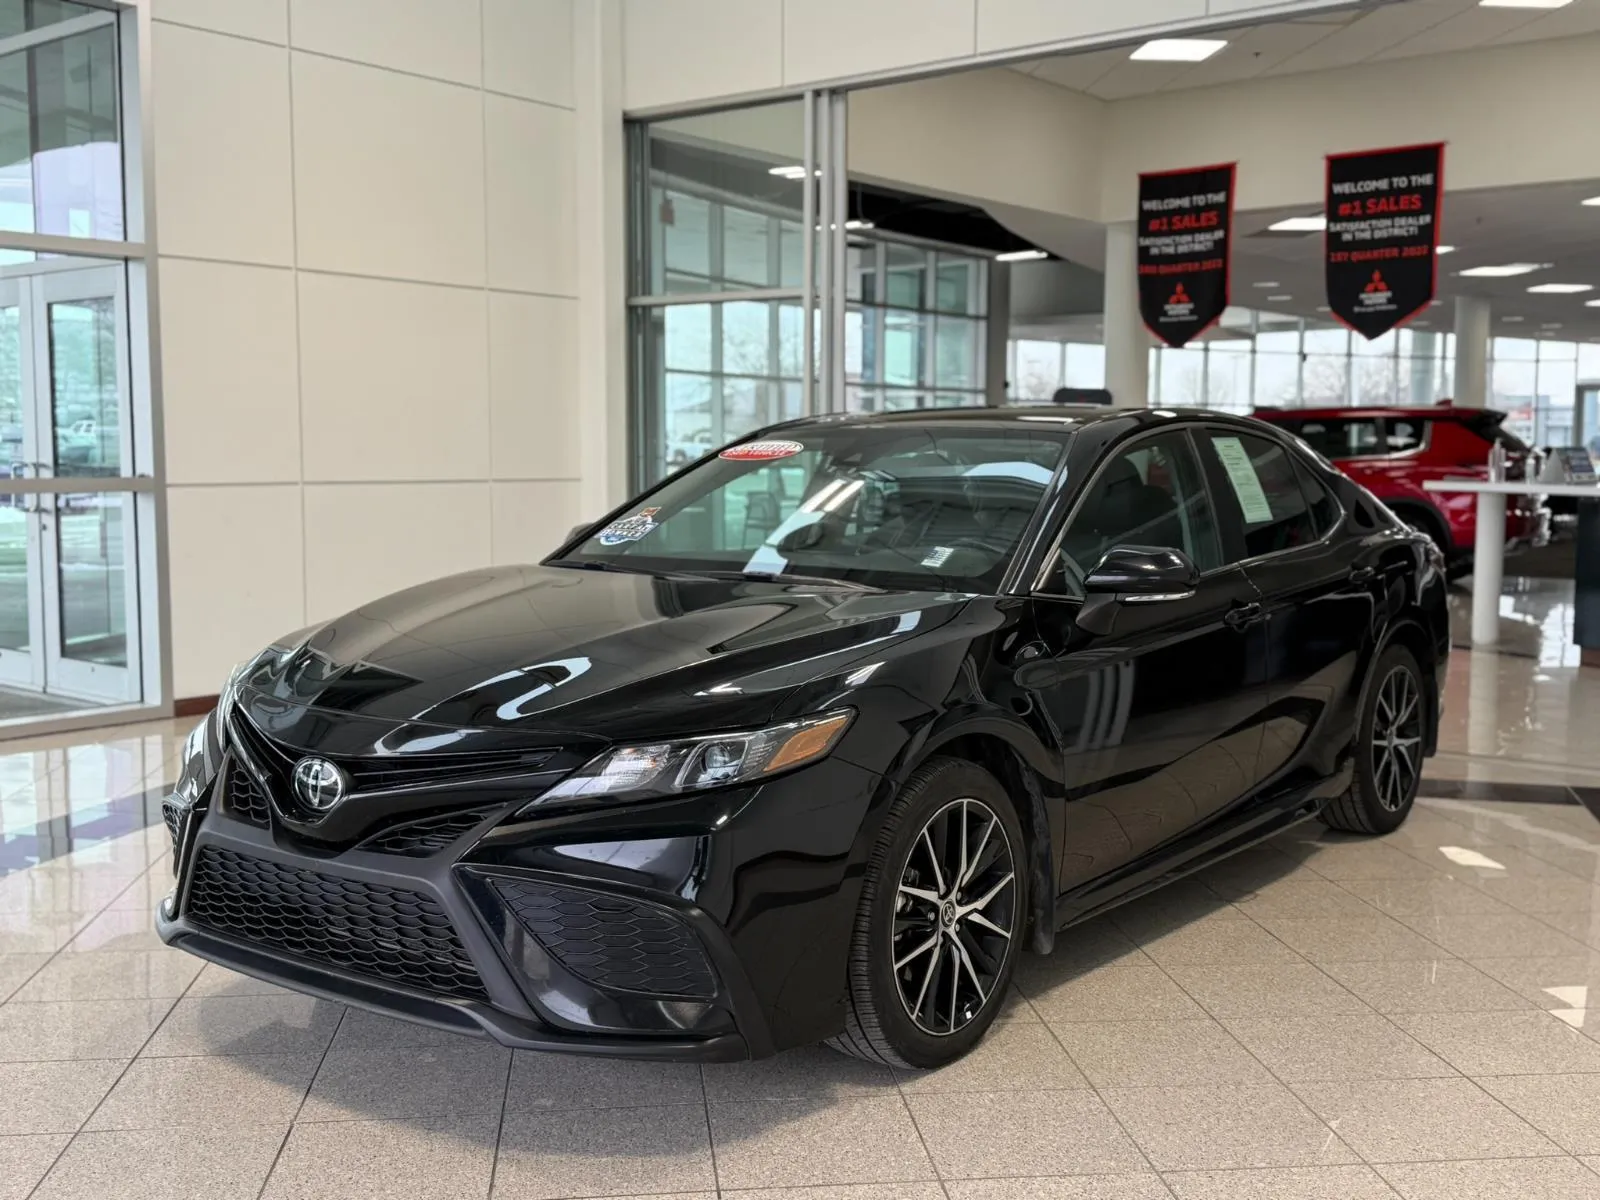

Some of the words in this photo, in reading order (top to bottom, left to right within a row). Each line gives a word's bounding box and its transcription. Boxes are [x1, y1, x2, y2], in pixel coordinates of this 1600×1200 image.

[1332, 178, 1389, 194] WELCOME
[1391, 176, 1408, 188] TO
[1409, 173, 1434, 187] THE
[1142, 196, 1190, 211] WELCOME
[1192, 194, 1206, 207] TO
[1206, 191, 1226, 204] THE
[1338, 200, 1362, 216] #1
[1366, 194, 1422, 214] SALES
[1171, 211, 1218, 230] SALES
[1329, 218, 1393, 232] SATISFACTION
[1394, 214, 1432, 227] DEALER
[1341, 232, 1353, 242] IN
[1354, 230, 1372, 240] THE
[1350, 247, 1399, 262] QUARTER
